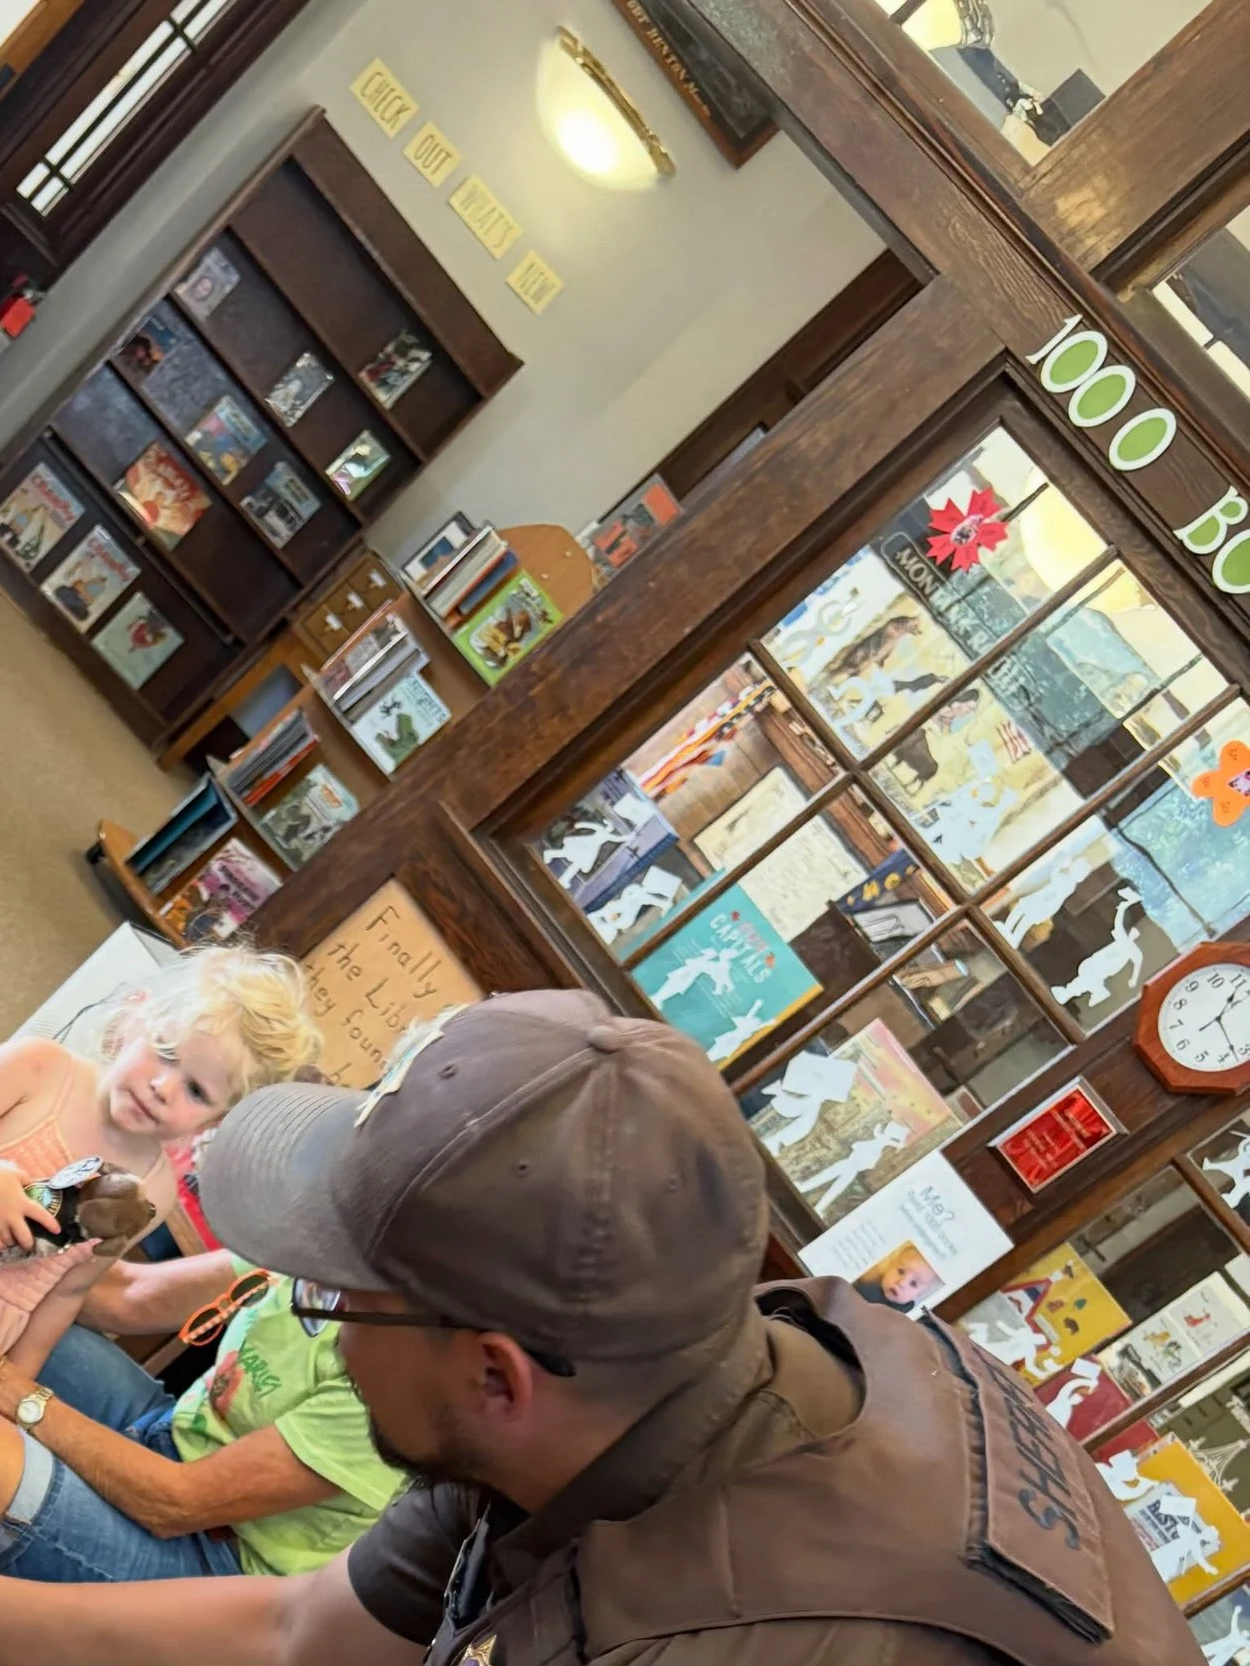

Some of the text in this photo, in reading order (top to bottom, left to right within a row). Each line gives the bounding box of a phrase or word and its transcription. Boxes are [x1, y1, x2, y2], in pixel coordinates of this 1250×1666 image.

[359, 71, 555, 306] CHECK OUT WHAT'S NEW
[1026, 313, 1177, 471] 1000
[365, 905, 439, 999] Finally
[326, 943, 363, 981] the
[1184, 980, 1200, 993] 9
[1207, 973, 1225, 989] 10
[305, 963, 338, 1018] they
[1173, 998, 1188, 1011] 8
[1169, 1019, 1184, 1030] 7
[1176, 1039, 1191, 1051] 6
[1194, 1050, 1210, 1063] 5
[1217, 1052, 1230, 1064] 4
[918, 1184, 957, 1224] Me?
